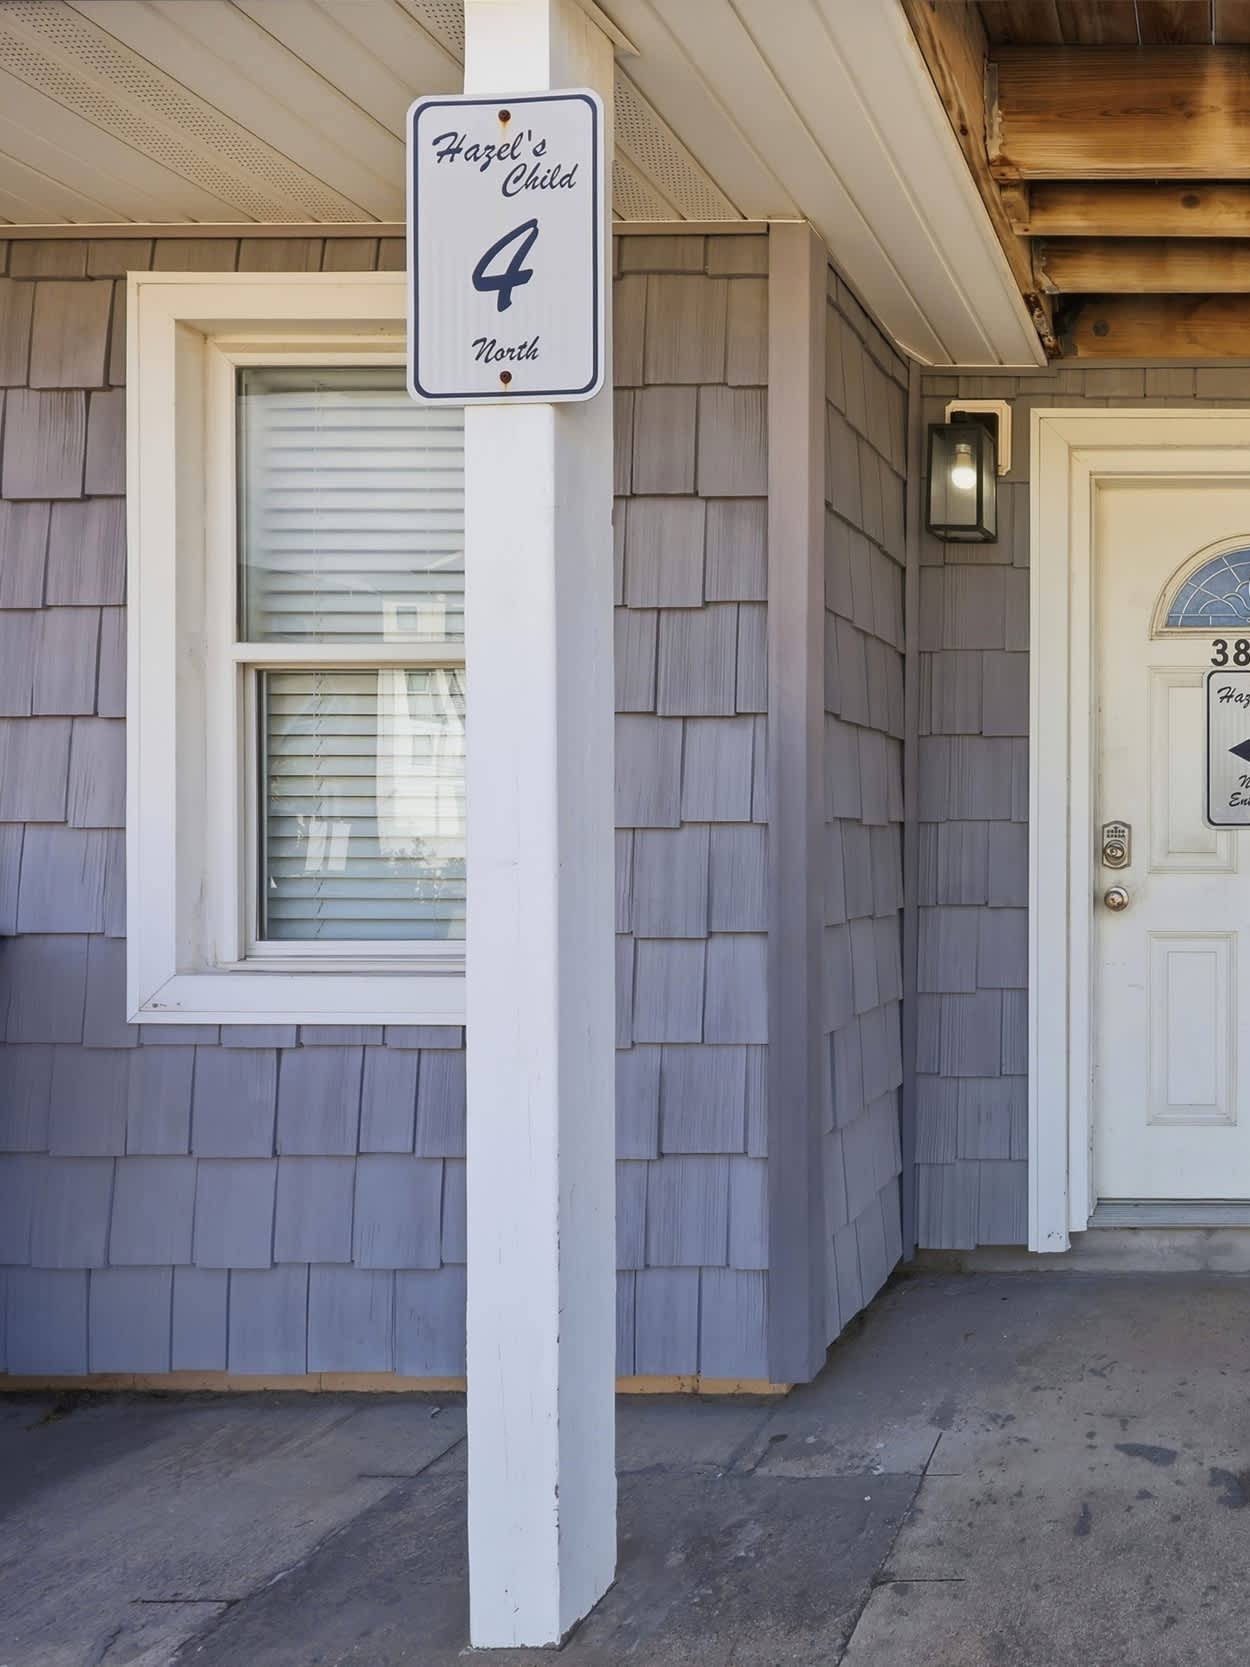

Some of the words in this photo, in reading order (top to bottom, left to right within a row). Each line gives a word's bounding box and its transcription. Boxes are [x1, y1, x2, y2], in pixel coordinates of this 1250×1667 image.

[432, 130, 547, 173] Hazel's
[502, 163, 579, 198] Child
[472, 219, 538, 312] 4
[472, 336, 540, 364] North
